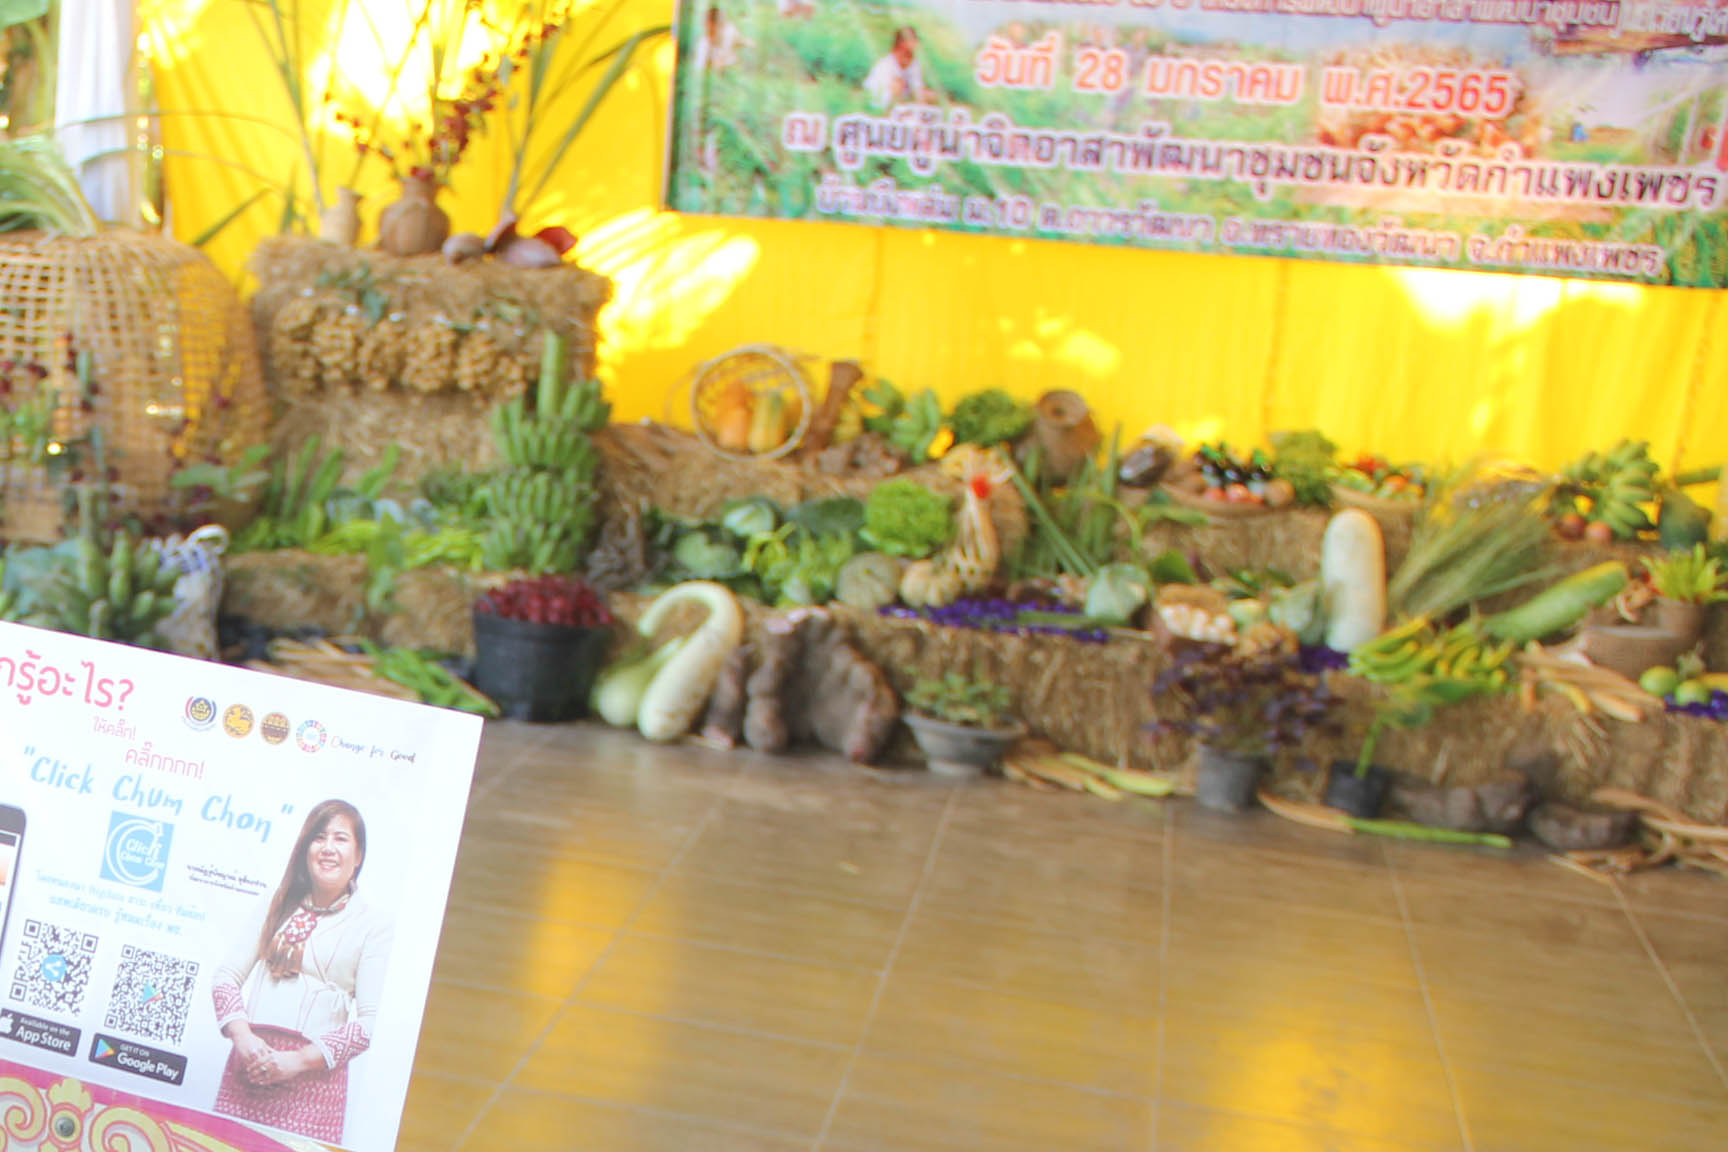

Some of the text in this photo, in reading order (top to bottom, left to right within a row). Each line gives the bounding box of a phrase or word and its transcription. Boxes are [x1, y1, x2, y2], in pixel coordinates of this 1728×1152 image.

[978, 31, 1511, 116] วันที่ 28 มกราคม พ.ศ.2565
[390, 749, 416, 764] Good
[111, 773, 183, 816] Chum
[16, 1026, 72, 1052] App Store
[117, 1052, 180, 1081] Google Play
